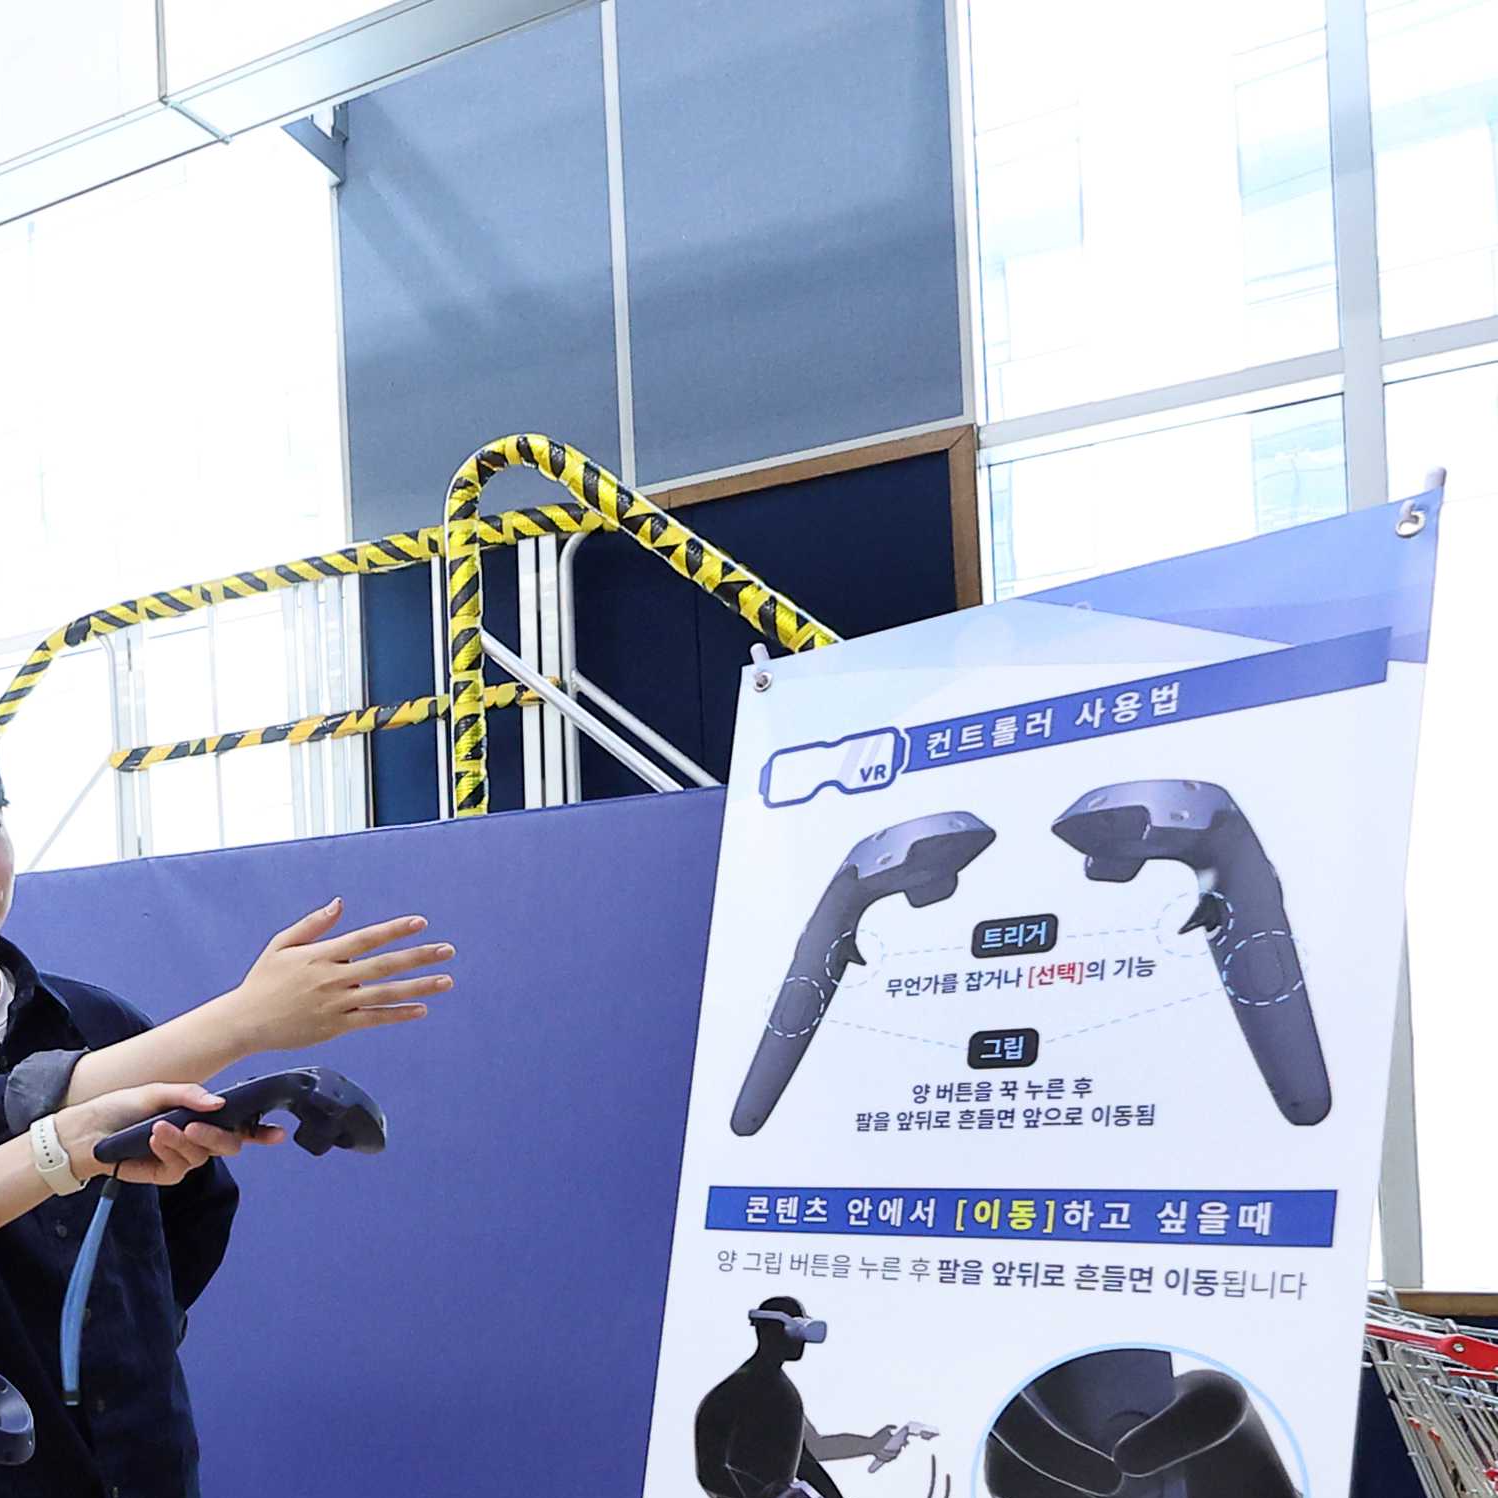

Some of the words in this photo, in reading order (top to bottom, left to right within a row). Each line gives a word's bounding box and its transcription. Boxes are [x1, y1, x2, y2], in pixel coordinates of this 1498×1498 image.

[927, 708, 1053, 757] 컨트롤러
[1075, 682, 1180, 729] 사용법
[859, 764, 886, 781] VR
[982, 922, 1048, 948] 트리거
[886, 972, 958, 997] 무언가를
[964, 966, 1022, 993] 잡거나
[1028, 958, 1105, 988] [선택]의
[1113, 957, 1156, 980] 기능
[980, 1036, 1024, 1060] 그립
[912, 1081, 931, 1104] 양
[935, 1080, 993, 1103] 버튼을
[999, 1080, 1018, 1102] 꾹
[1025, 1079, 1065, 1100] 누른
[1073, 1078, 1093, 1098] 후
[855, 1111, 891, 1132] 팔을
[895, 1109, 951, 1131] 앞뒤로
[956, 1109, 1014, 1131] 흔들면
[1022, 1105, 1084, 1129] 앞으로
[1091, 1104, 1155, 1127] 이동됨
[745, 1197, 829, 1223] 콘텐츠
[847, 1198, 935, 1227] 안에서
[954, 1199, 1131, 1233] [이동]하고
[1156, 1200, 1272, 1236] 싶을때
[717, 1250, 737, 1273] 양
[742, 1251, 783, 1275] 그립
[789, 1251, 851, 1279] 버튼을
[858, 1257, 902, 1280] 누른
[910, 1256, 931, 1281] 후
[938, 1260, 983, 1285] 팔을
[992, 1261, 1065, 1289] 앞뒤로
[1074, 1265, 1154, 1294] 흔들면
[1163, 1267, 1308, 1299] 이동됩니다
